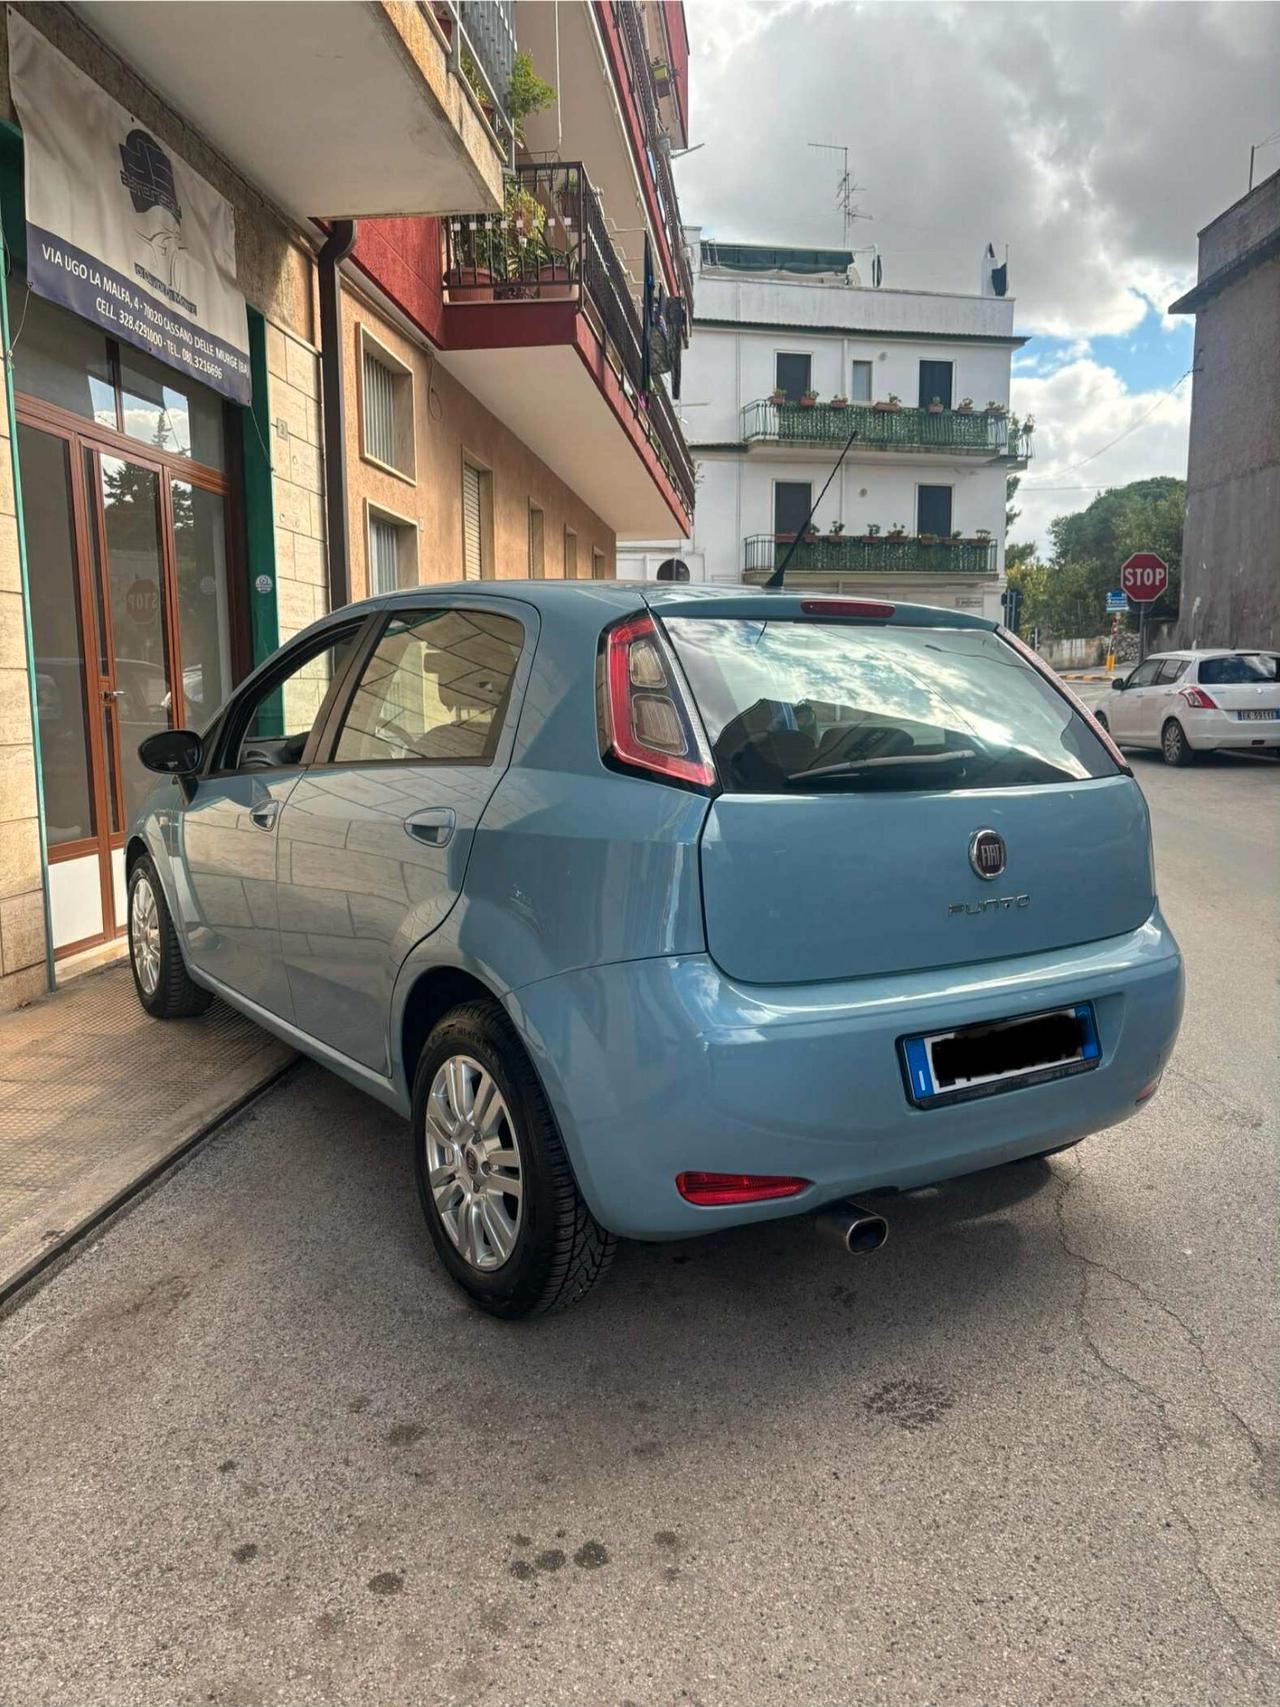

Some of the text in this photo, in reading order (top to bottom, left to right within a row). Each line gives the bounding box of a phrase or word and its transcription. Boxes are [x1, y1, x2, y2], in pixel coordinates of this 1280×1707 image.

[42, 243, 63, 267] VIA
[65, 255, 88, 280] UGO
[89, 268, 102, 288] LA
[103, 277, 133, 309] MALFA,
[133, 297, 140, 311] 4
[163, 317, 193, 345] CASSANO
[194, 336, 215, 357] DELLE
[215, 347, 238, 370] MURGE
[96, 297, 117, 321] CELL.
[166, 339, 181, 358] TEL.
[1125, 568, 1165, 586] STOP
[981, 844, 1000, 867] FIAT
[948, 894, 1031, 916] PUNTO
